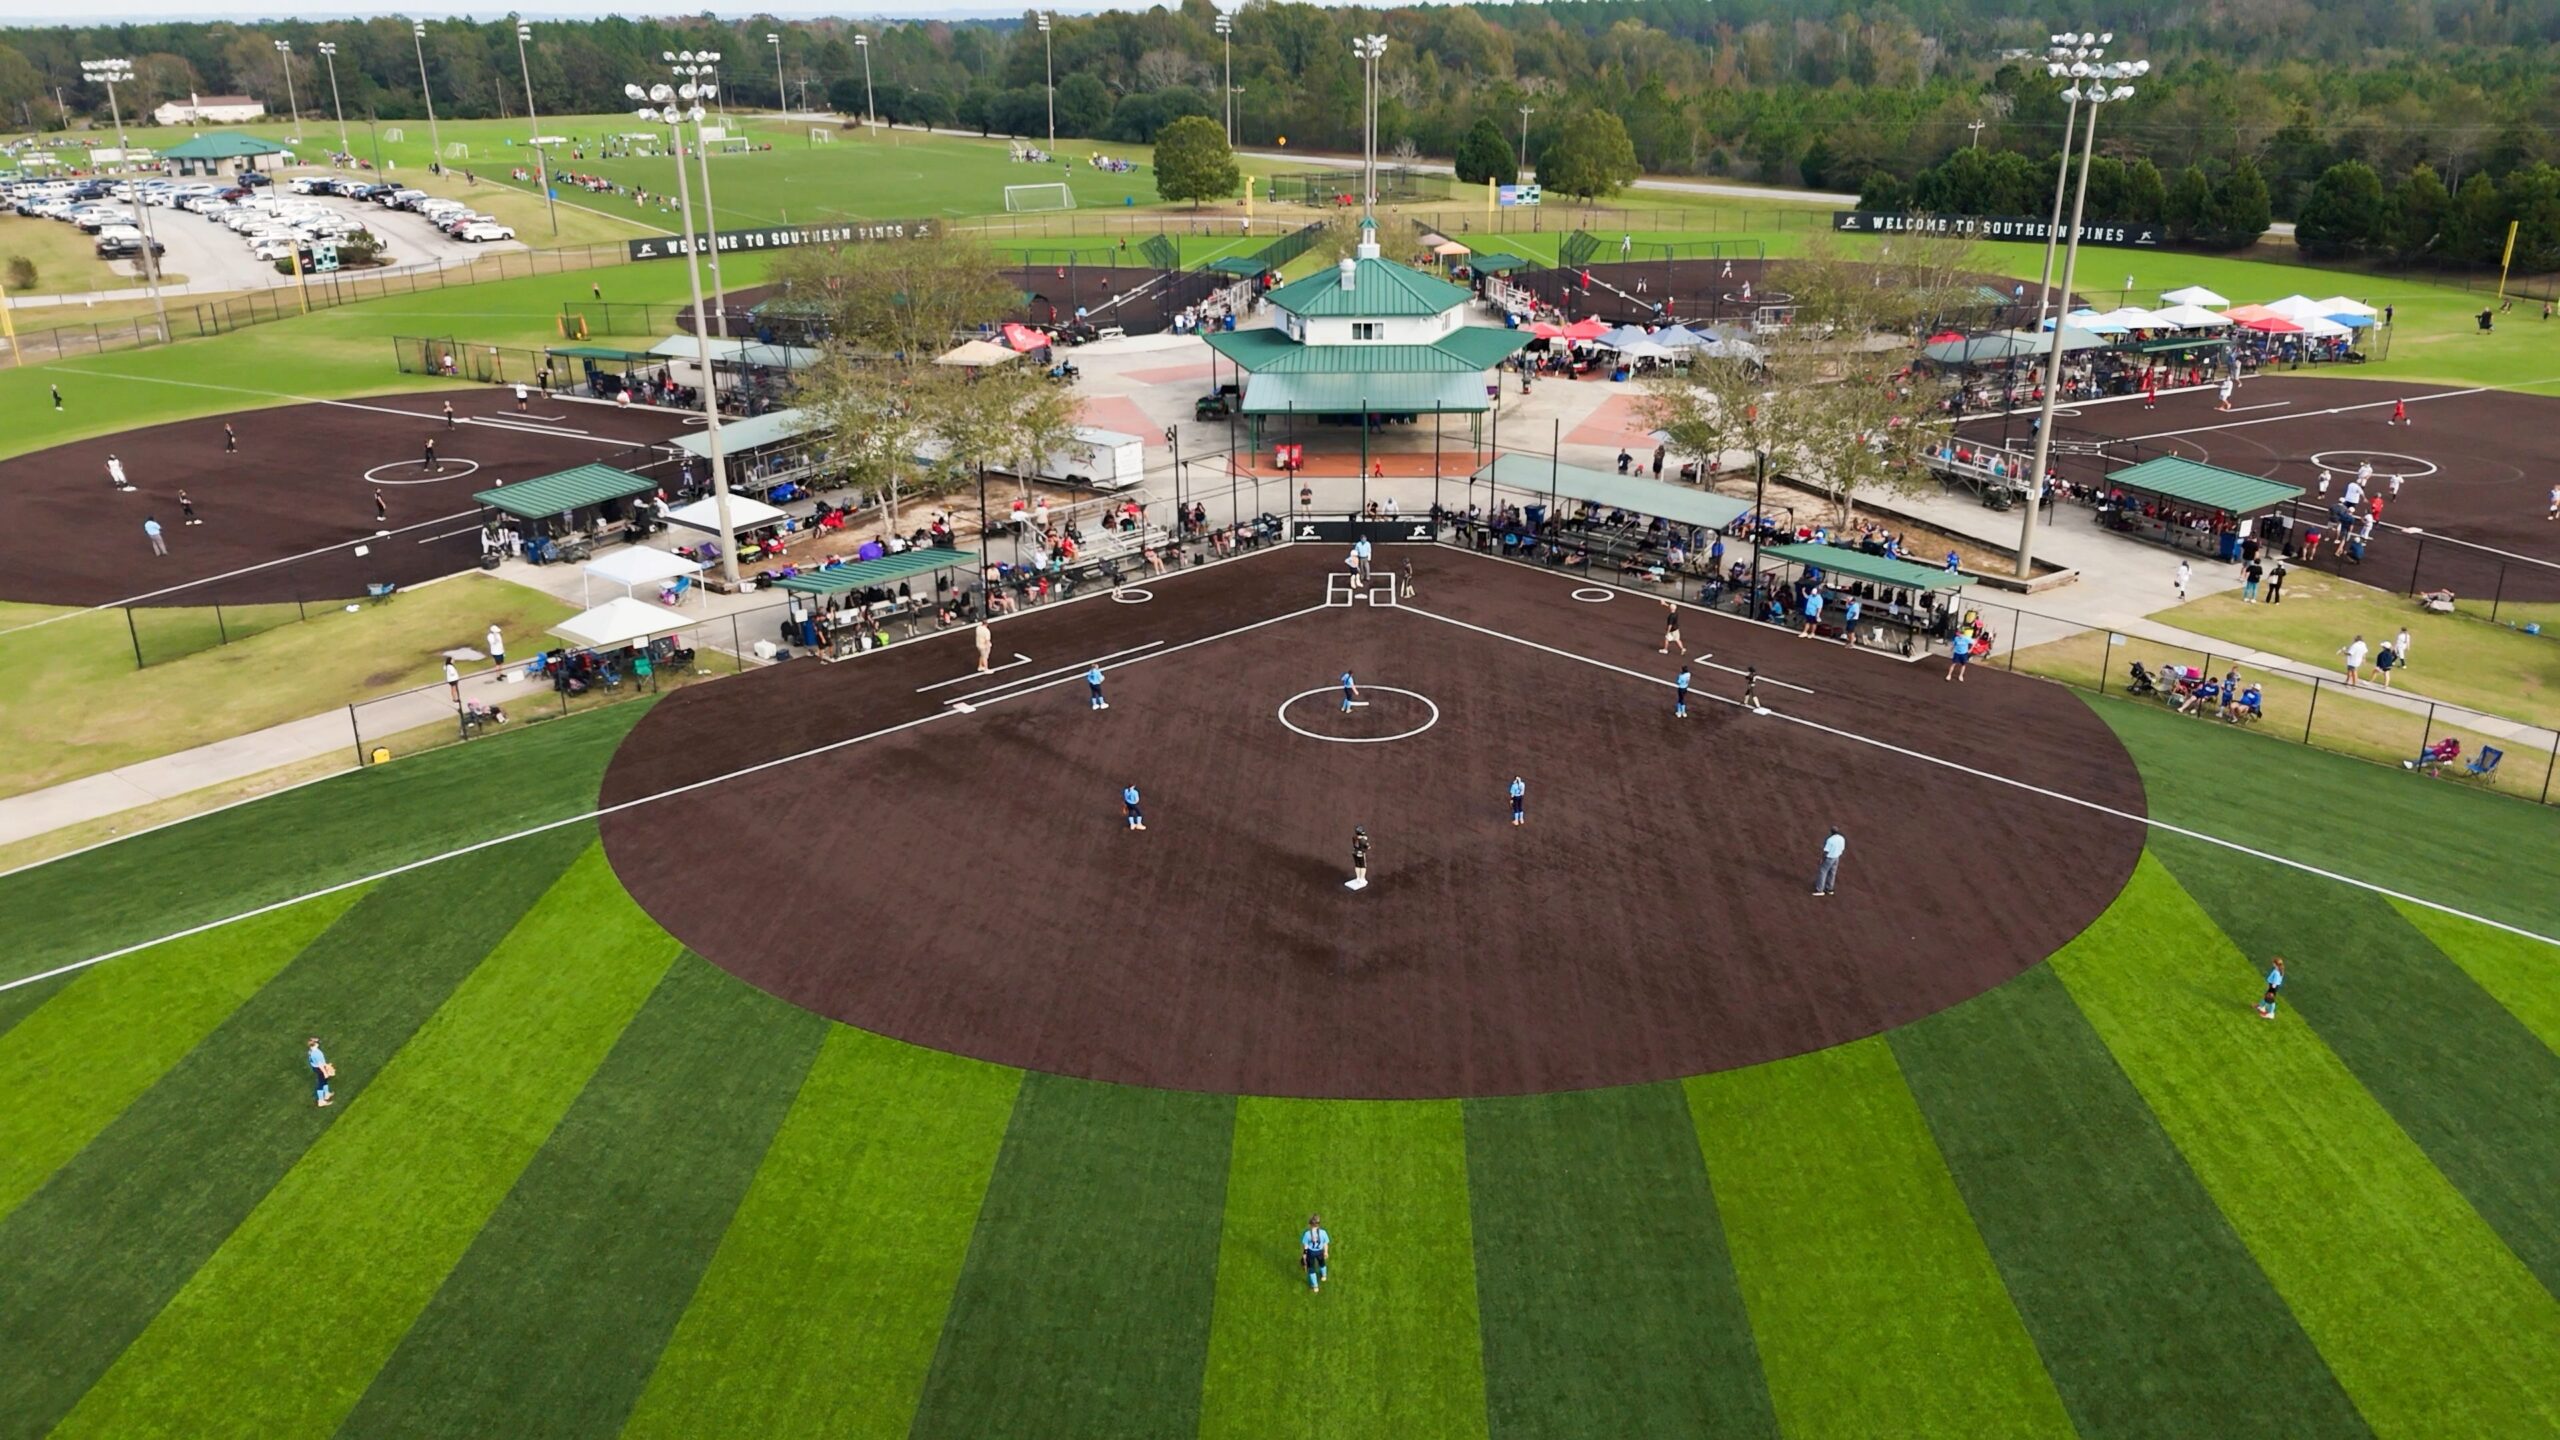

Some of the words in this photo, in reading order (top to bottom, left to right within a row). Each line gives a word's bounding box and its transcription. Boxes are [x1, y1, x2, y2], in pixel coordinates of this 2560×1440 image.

[1872, 216, 1947, 232] WELCOME
[1956, 219, 1975, 233] TO
[2077, 226, 2125, 242] PINES
[666, 235, 739, 254] WECME
[745, 233, 765, 248] TO
